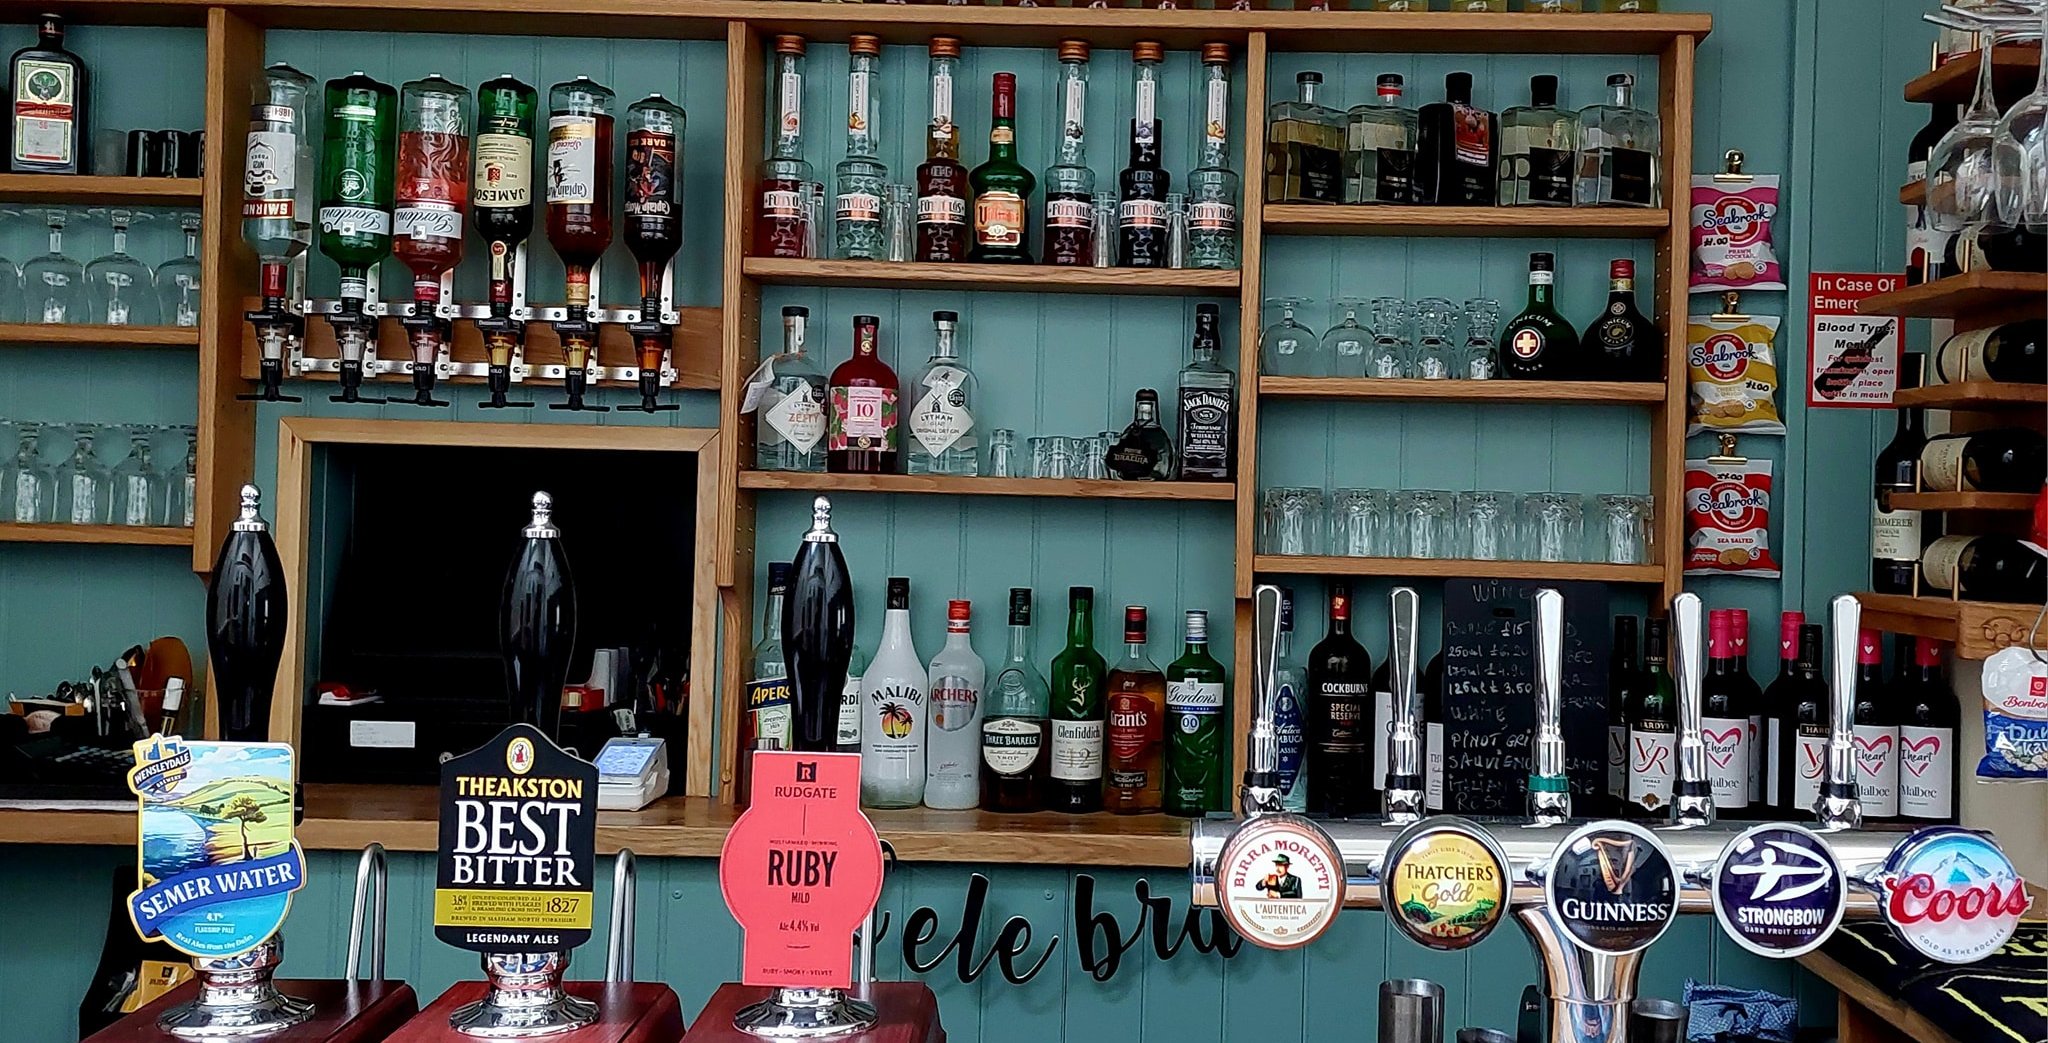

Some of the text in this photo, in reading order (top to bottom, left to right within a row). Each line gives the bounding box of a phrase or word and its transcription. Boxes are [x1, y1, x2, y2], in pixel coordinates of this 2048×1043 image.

[641, 137, 667, 146] DARK
[557, 182, 588, 199] Captain
[642, 199, 671, 215] Captain
[1702, 203, 1771, 229] Seabrook
[1818, 276, 1896, 292] In Case Of
[1509, 314, 1554, 330] UNICUM
[1602, 317, 1631, 330] UNICUM
[1817, 322, 1855, 333] Blood
[1690, 343, 1759, 367] Seabrook
[1872, 368, 1895, 377] open
[1858, 379, 1884, 388] place
[1849, 390, 1858, 398] in
[1860, 391, 1889, 399] mouth
[856, 403, 874, 417] 10
[1184, 394, 1230, 413] JACK DANIEL'S
[788, 413, 820, 423] ZESTY
[920, 414, 954, 422] LYTHAM
[1697, 489, 1763, 513] Seabrook
[1500, 620, 1532, 638] £15
[871, 685, 924, 706] MALIBU
[931, 688, 979, 703] ARCHERS
[1169, 685, 1218, 704] Gordon's
[1330, 703, 1361, 712] SPECIAL
[1330, 711, 1361, 720] RESERVE
[1110, 710, 1147, 727] Grant's
[985, 734, 1037, 746] THREE BARRELS
[1058, 725, 1101, 739] Glenfiddich
[1711, 740, 1737, 755] heart
[1907, 747, 1933, 763] heart
[134, 752, 190, 785] WENSLEYDALE
[156, 774, 182, 788] BREWERY
[455, 776, 583, 799] THEAKSTON
[774, 787, 837, 799] RUDGATE
[1901, 785, 1937, 798] Malbec
[452, 800, 582, 855] BEST
[451, 855, 582, 886] BITTER
[768, 849, 838, 887] RUBY
[1233, 839, 1330, 891] BIRRA MORETTI
[1404, 863, 1494, 881] THATCHERS
[139, 861, 296, 920] SEMER WATER
[791, 891, 810, 903] MILD
[1421, 881, 1475, 910] Gold
[545, 897, 580, 913] 1827
[1885, 873, 2030, 925] Coors
[1255, 903, 1307, 915] L'AUTENTICA
[1562, 898, 1669, 922] GUINNESS
[1737, 906, 1826, 926] STRONGBOW
[221, 926, 235, 934] PALE
[790, 920, 809, 932] 4.4%
[1744, 926, 1817, 935] DARK FRUIT CIDER
[175, 932, 192, 945] Real
[191, 940, 206, 950] Ales
[466, 932, 560, 944] LEGENDARY ALES
[1918, 928, 2006, 956] COLD AS THE ROCKIES
[810, 969, 833, 977] VELVET
